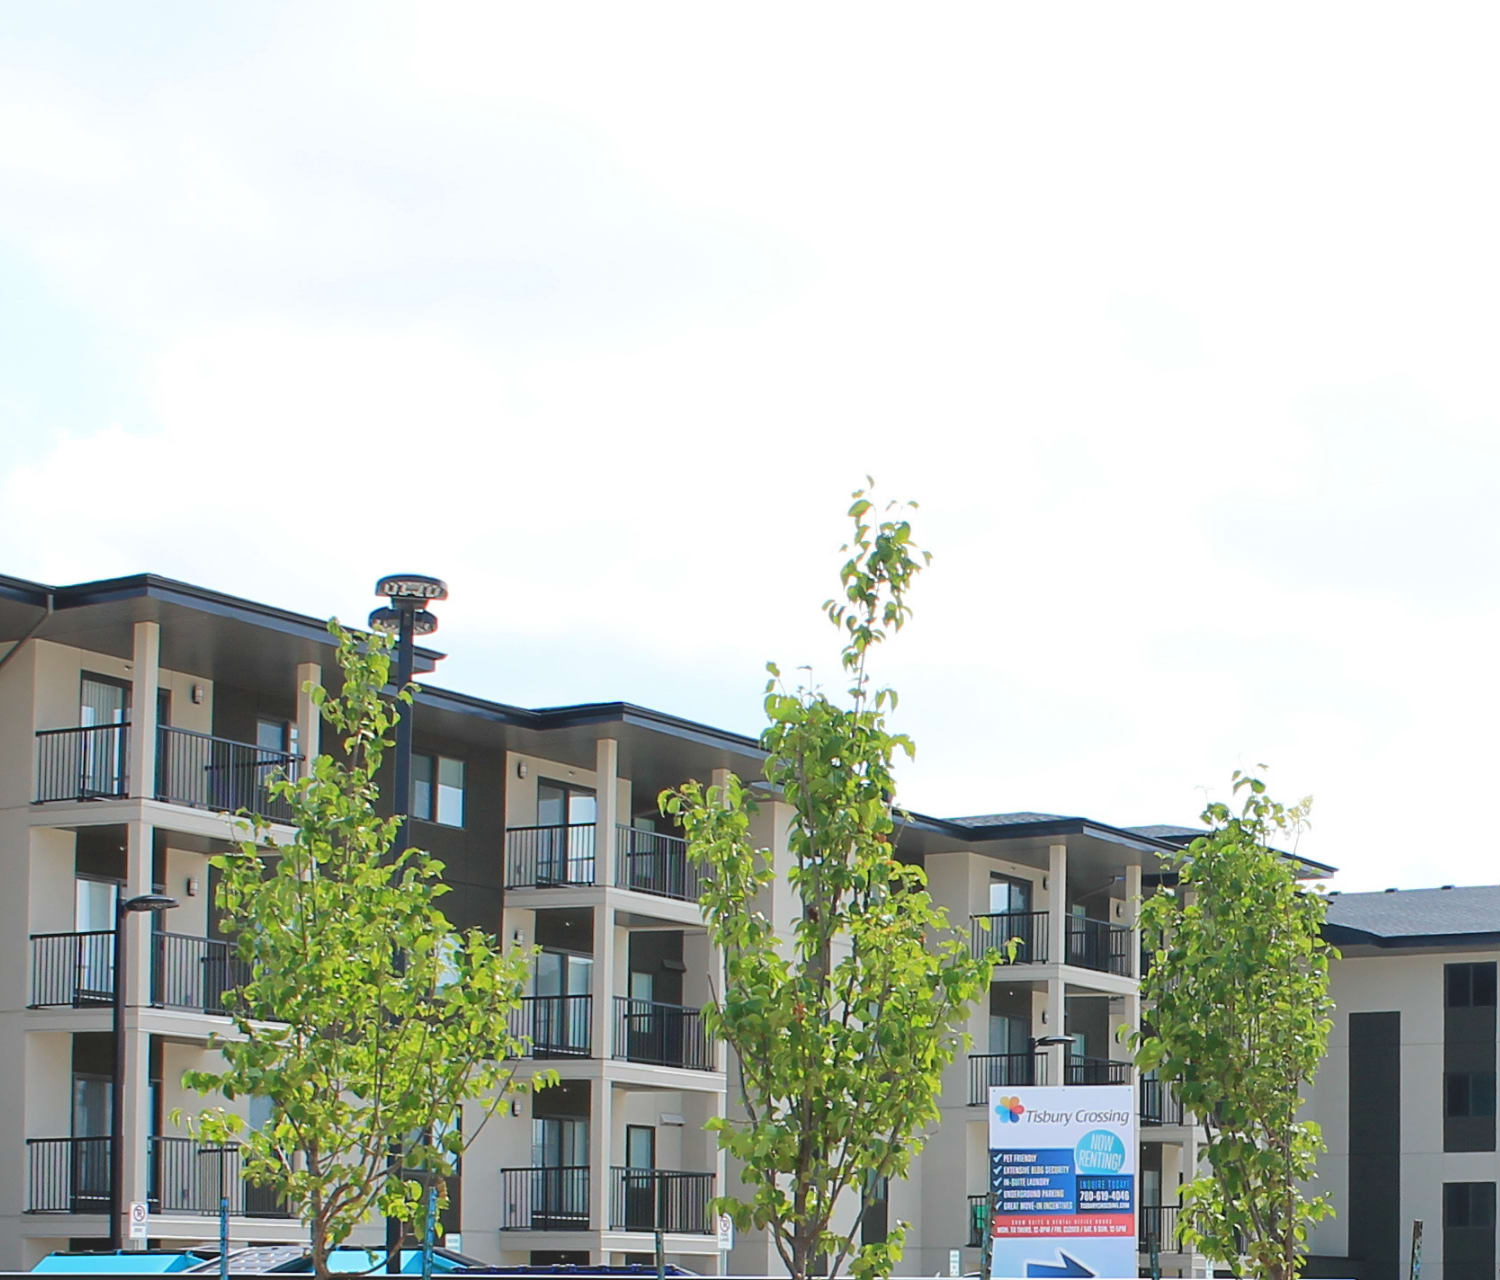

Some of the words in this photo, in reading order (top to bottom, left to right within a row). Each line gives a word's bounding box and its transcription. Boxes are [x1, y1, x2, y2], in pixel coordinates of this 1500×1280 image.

[1026, 1110, 1073, 1127] Tisbury
[1075, 1109, 1130, 1127] Crossing
[1091, 1133, 1115, 1152] NOW
[1003, 1154, 1013, 1162] PET
[1013, 1154, 1037, 1162] FRIENDLY
[1079, 1149, 1122, 1171] RENTING!
